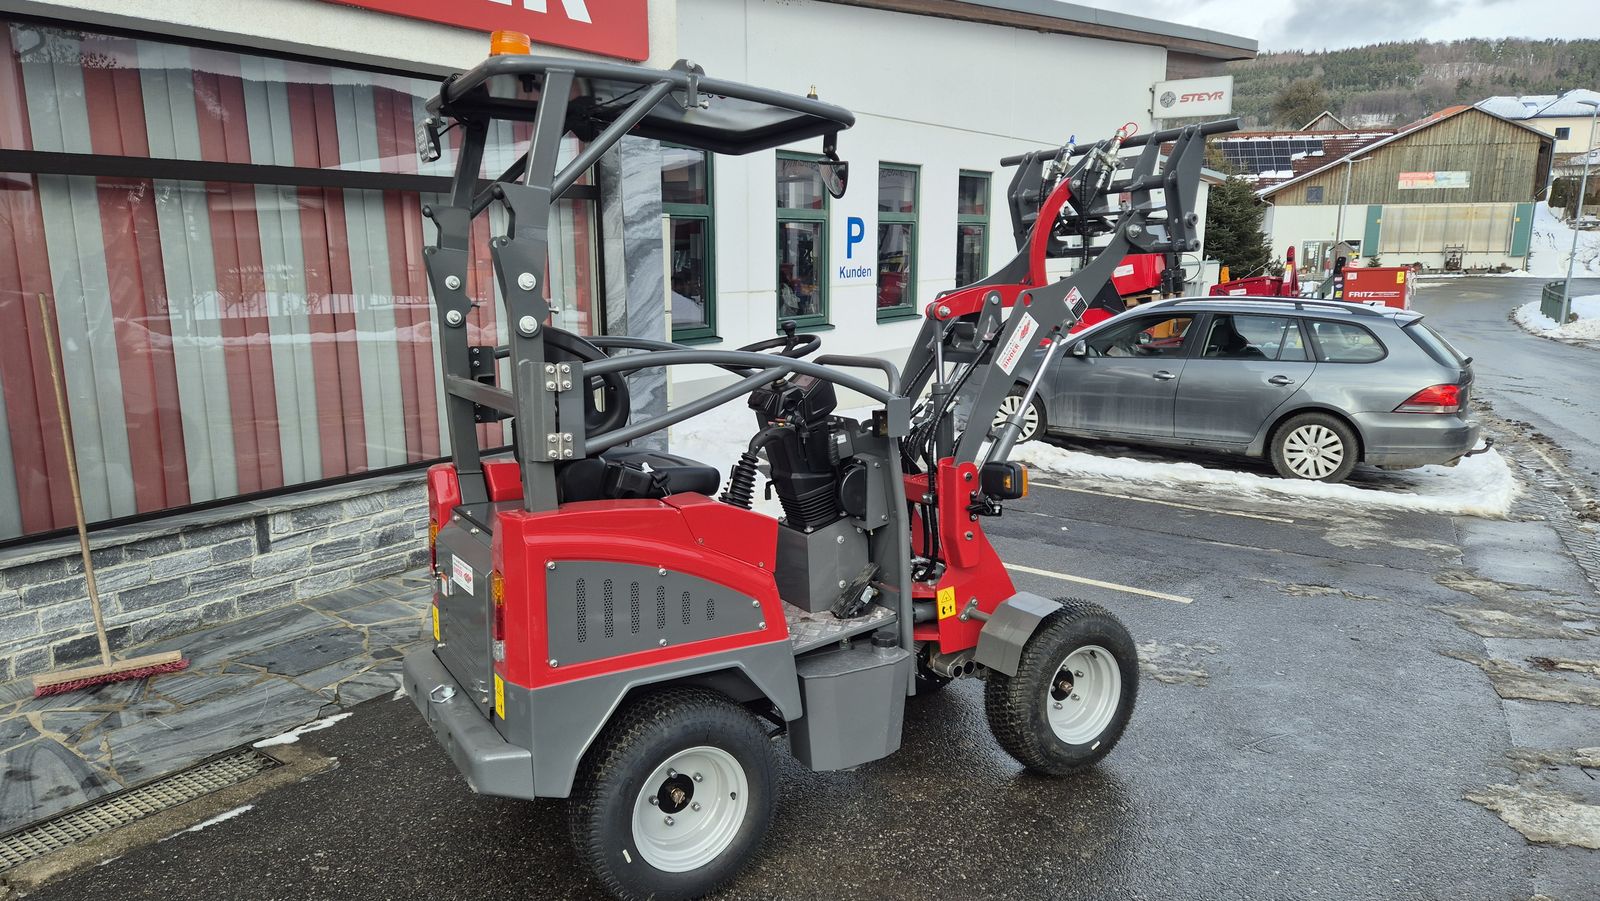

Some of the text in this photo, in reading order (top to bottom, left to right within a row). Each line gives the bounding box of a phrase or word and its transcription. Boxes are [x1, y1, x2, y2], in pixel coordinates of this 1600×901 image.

[1179, 91, 1224, 103] STEYR
[847, 216, 865, 259] P
[839, 265, 872, 279] Kunden
